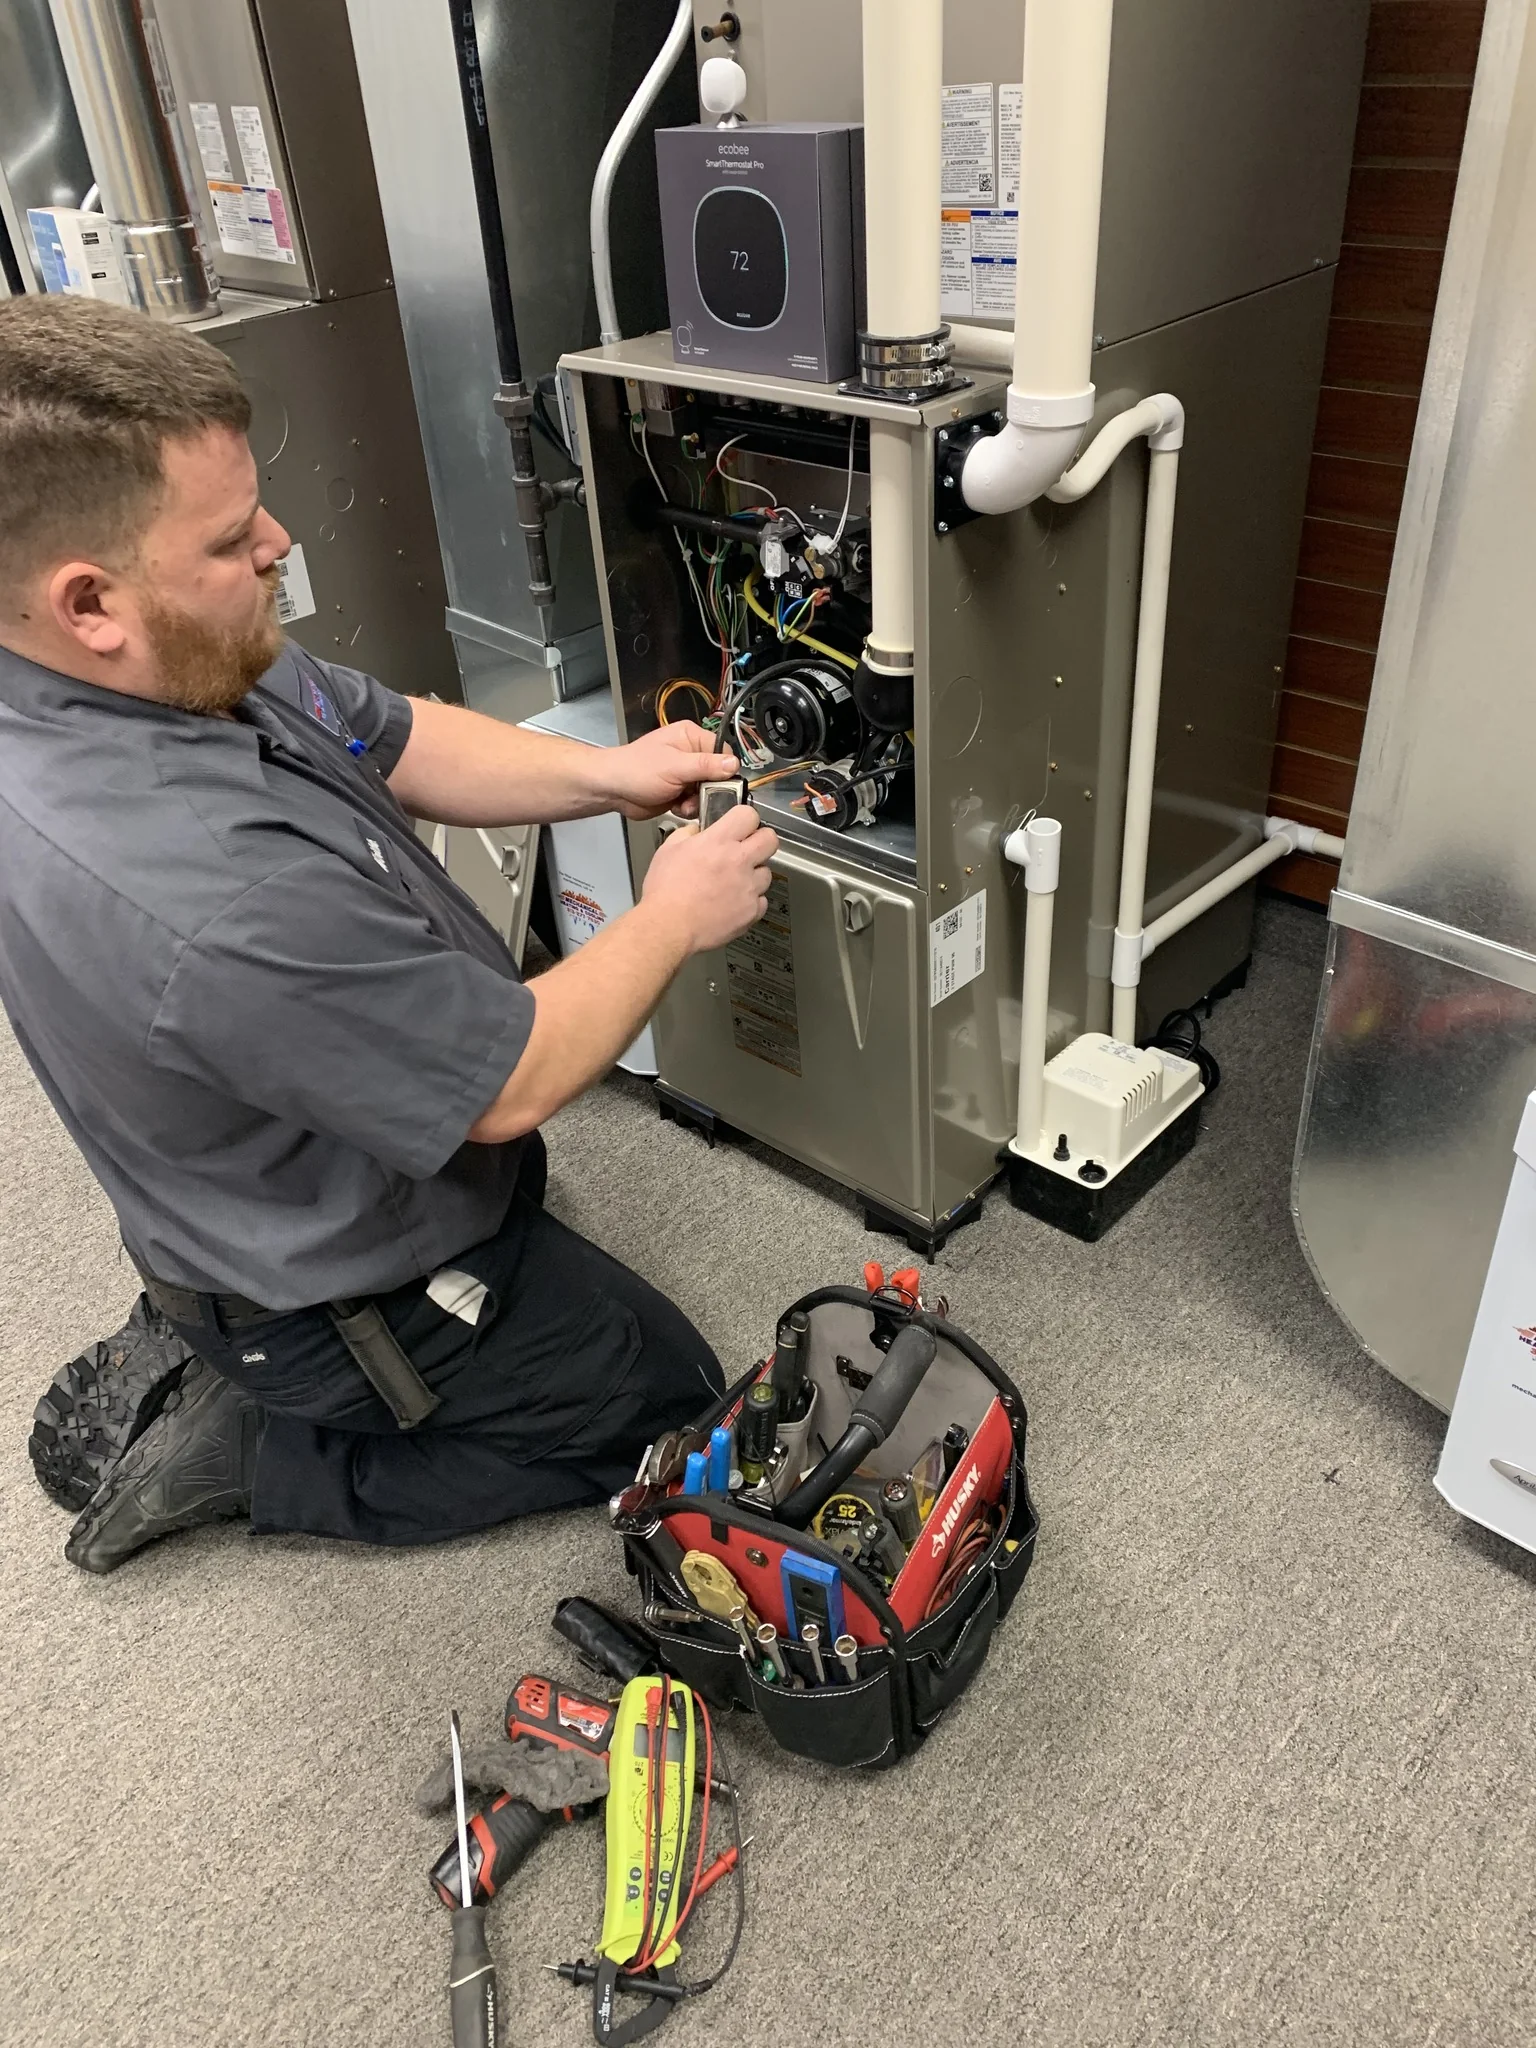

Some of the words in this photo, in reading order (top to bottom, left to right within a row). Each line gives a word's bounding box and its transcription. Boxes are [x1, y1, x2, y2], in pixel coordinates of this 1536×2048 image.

[718, 143, 749, 155] ecobee
[705, 159, 753, 169] SmartThermostat
[753, 160, 765, 169] Pro
[730, 251, 749, 271] 72
[941, 1463, 980, 1537] HUSKY
[487, 2001, 495, 2048] HUSKY
